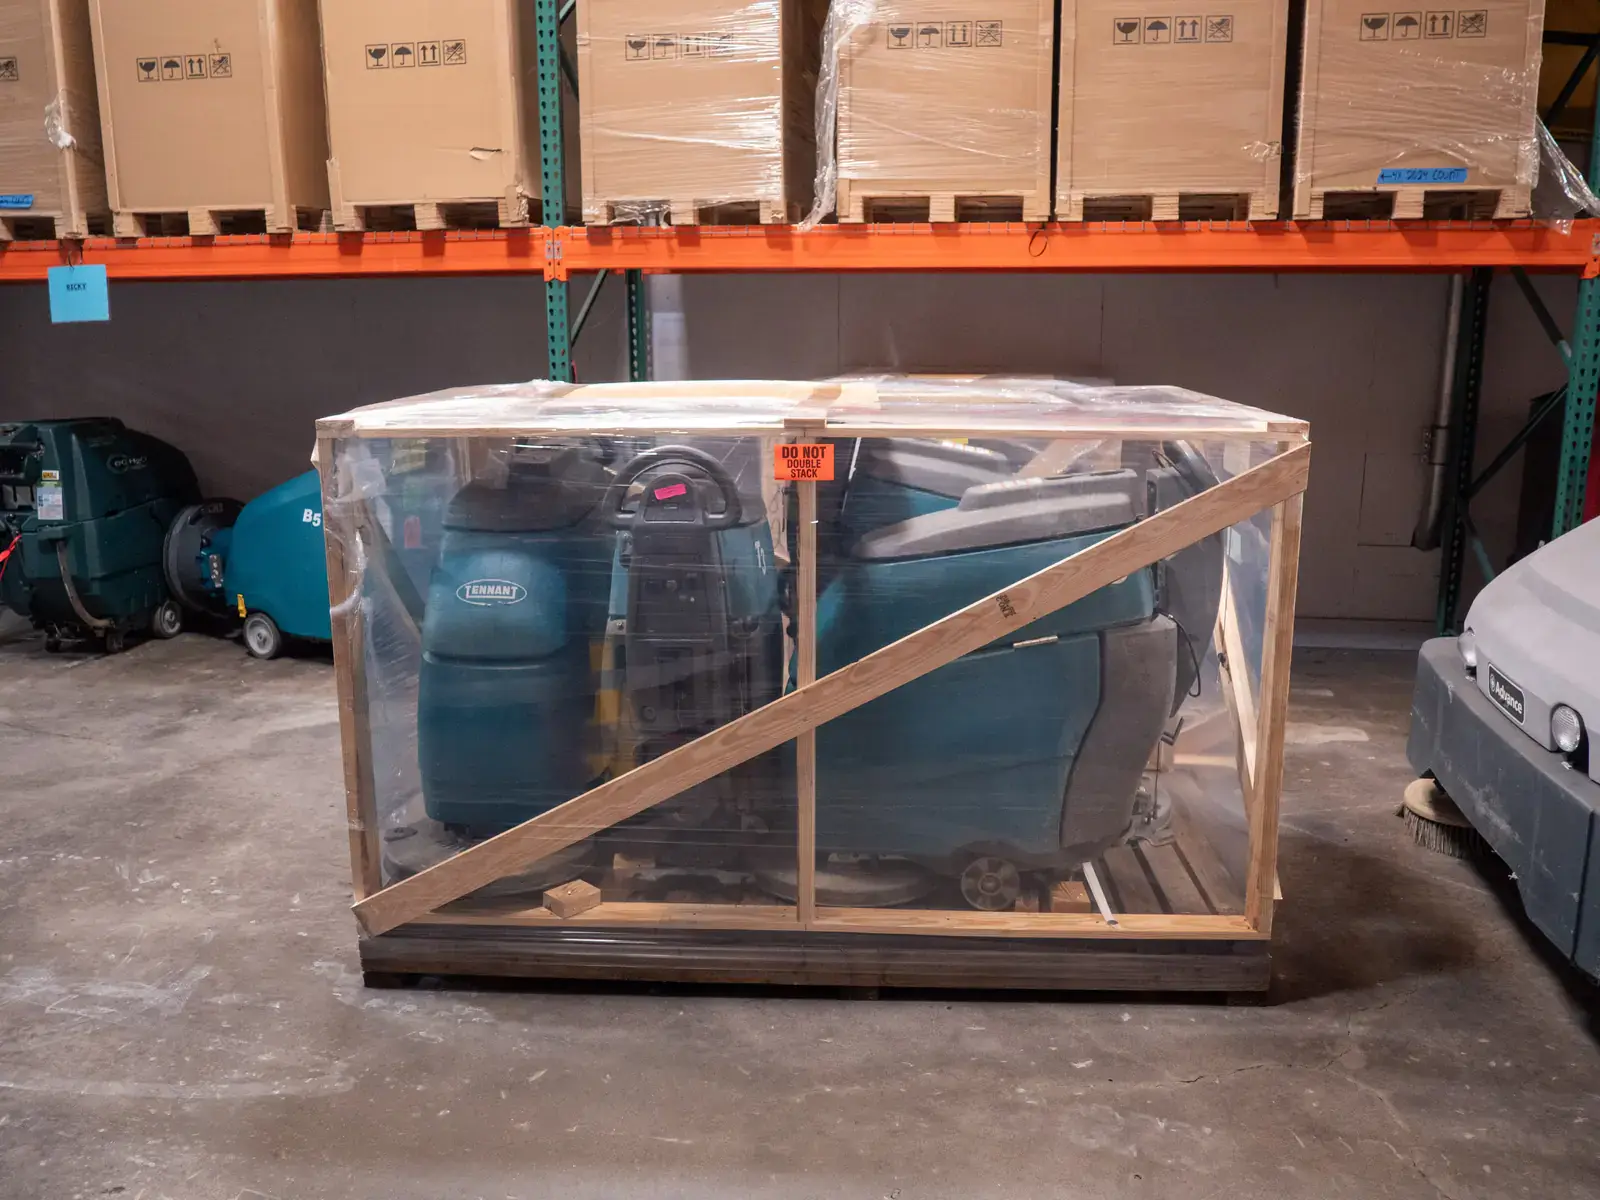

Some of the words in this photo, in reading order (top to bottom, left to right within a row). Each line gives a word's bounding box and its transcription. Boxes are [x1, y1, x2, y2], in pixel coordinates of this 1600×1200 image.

[782, 446, 798, 459] DO
[803, 446, 827, 459] NOT
[787, 459, 821, 469] DOUBLE
[790, 469, 818, 478] STACK
[302, 508, 322, 527] B5
[465, 585, 518, 599] TENNANT
[1495, 681, 1523, 715] Advance
